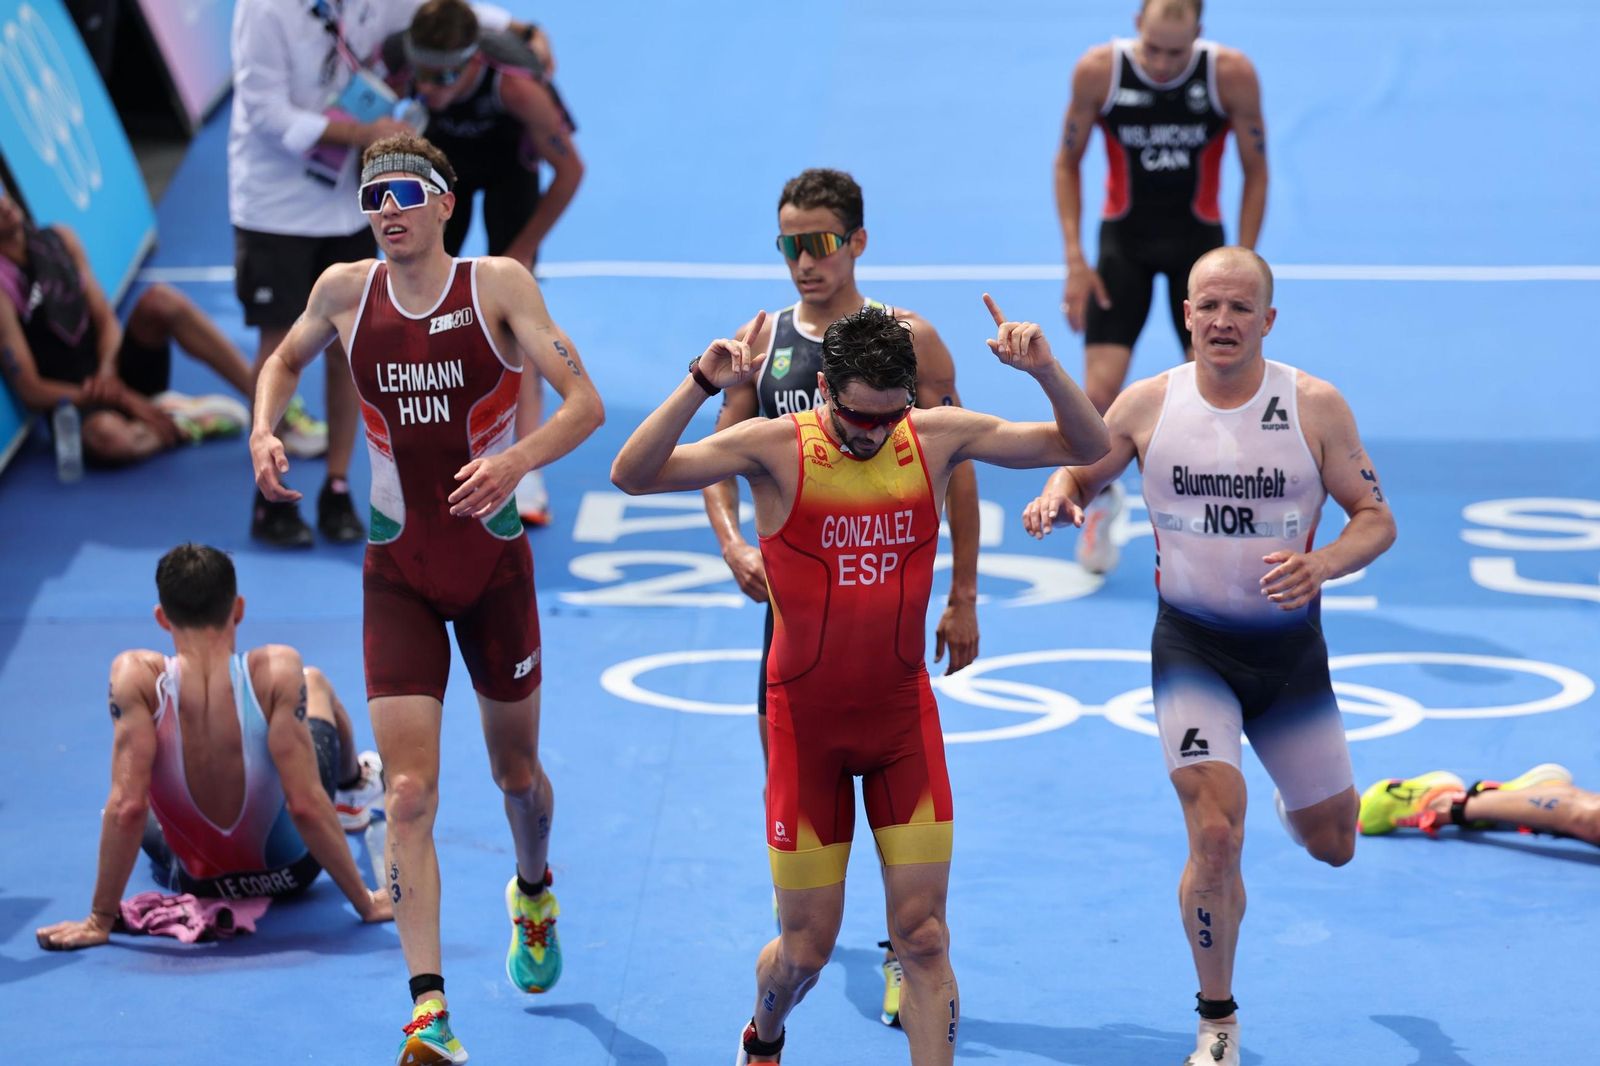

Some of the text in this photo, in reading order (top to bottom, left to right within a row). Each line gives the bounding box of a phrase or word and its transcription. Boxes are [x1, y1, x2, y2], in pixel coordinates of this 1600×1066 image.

[1140, 147, 1190, 171] CAN
[376, 359, 464, 393] LEHMANN
[397, 395, 450, 425] HUN
[774, 388, 826, 416] HIDA
[1172, 465, 1286, 499] Blummenfelt
[821, 510, 916, 549] GONZALEZ
[1203, 503, 1256, 534] NOR
[838, 552, 898, 586] ESP
[214, 867, 298, 901] LE CORRE
[1197, 907, 1213, 949] 43
[947, 999, 956, 1045] 15
